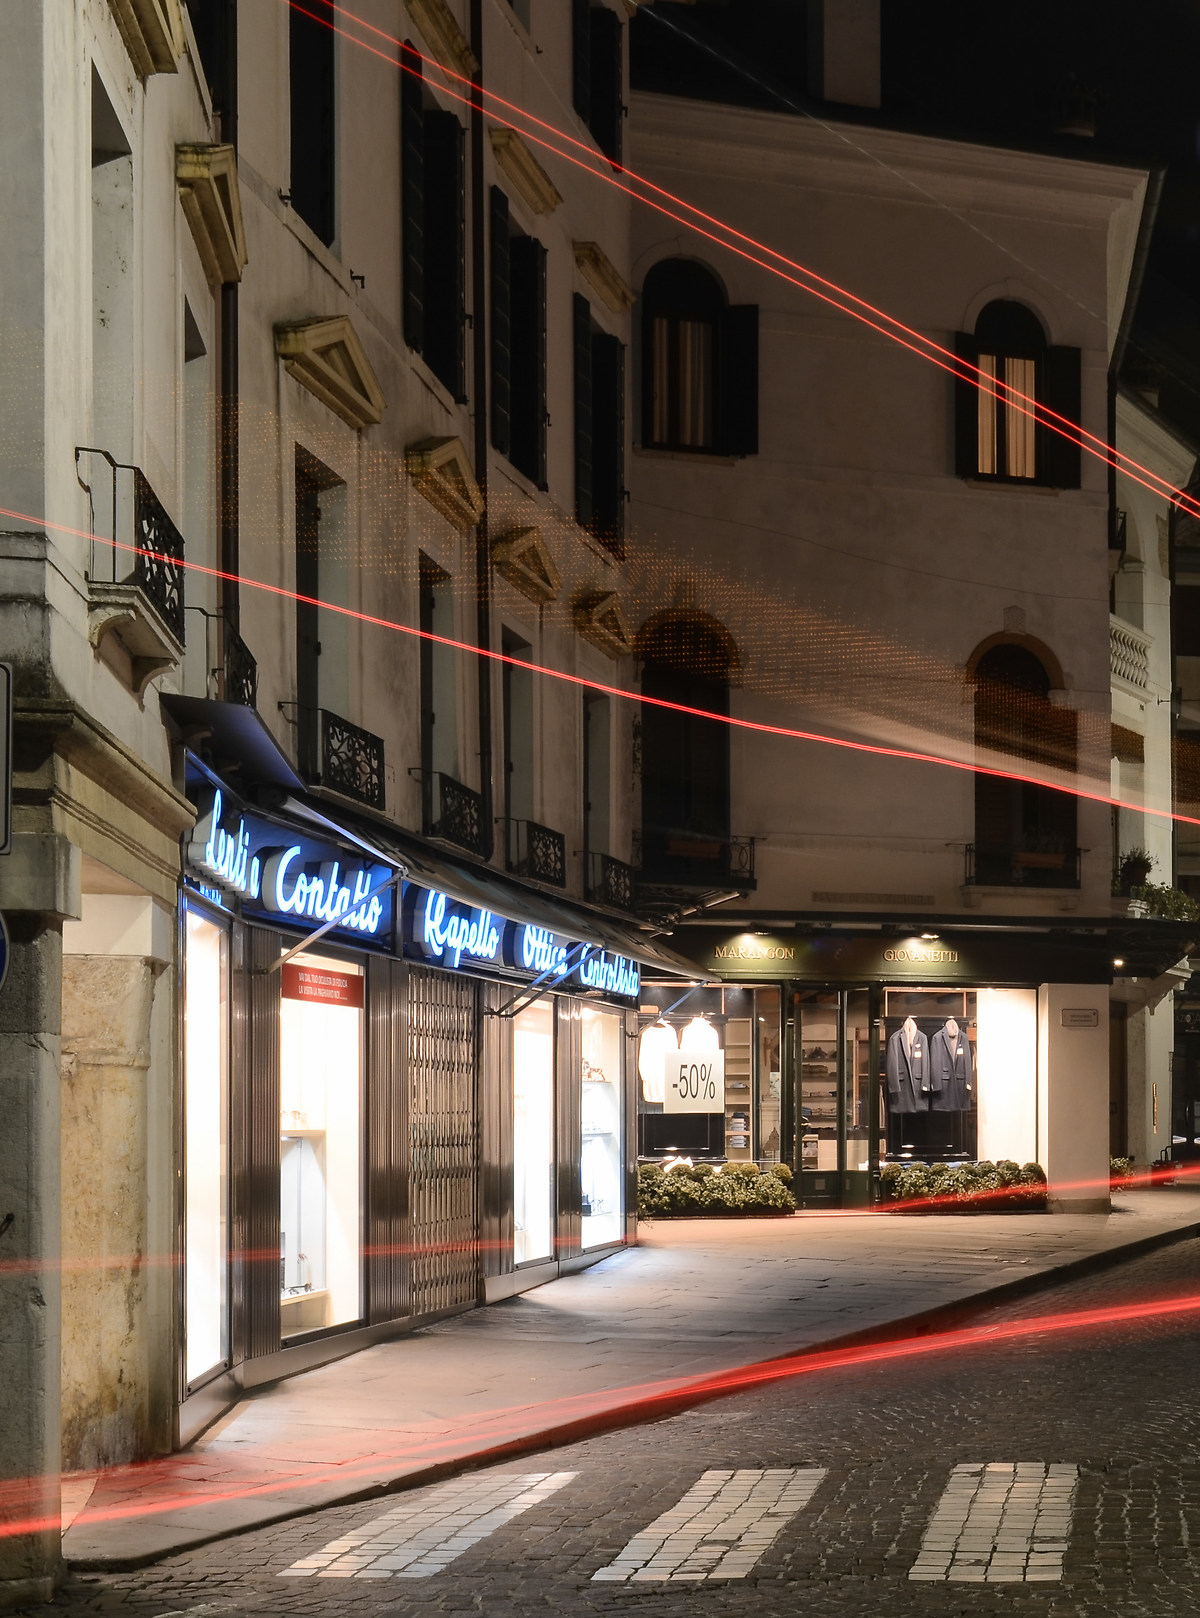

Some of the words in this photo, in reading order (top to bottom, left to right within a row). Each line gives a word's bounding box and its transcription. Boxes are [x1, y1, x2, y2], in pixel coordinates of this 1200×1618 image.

[205, 789, 250, 892] Lenti
[276, 845, 383, 934] Contatto
[523, 924, 568, 976] Ottica
[714, 946, 795, 960] MARANGON
[883, 949, 960, 963] GIOVANETTI
[672, 1063, 716, 1100] -50%
